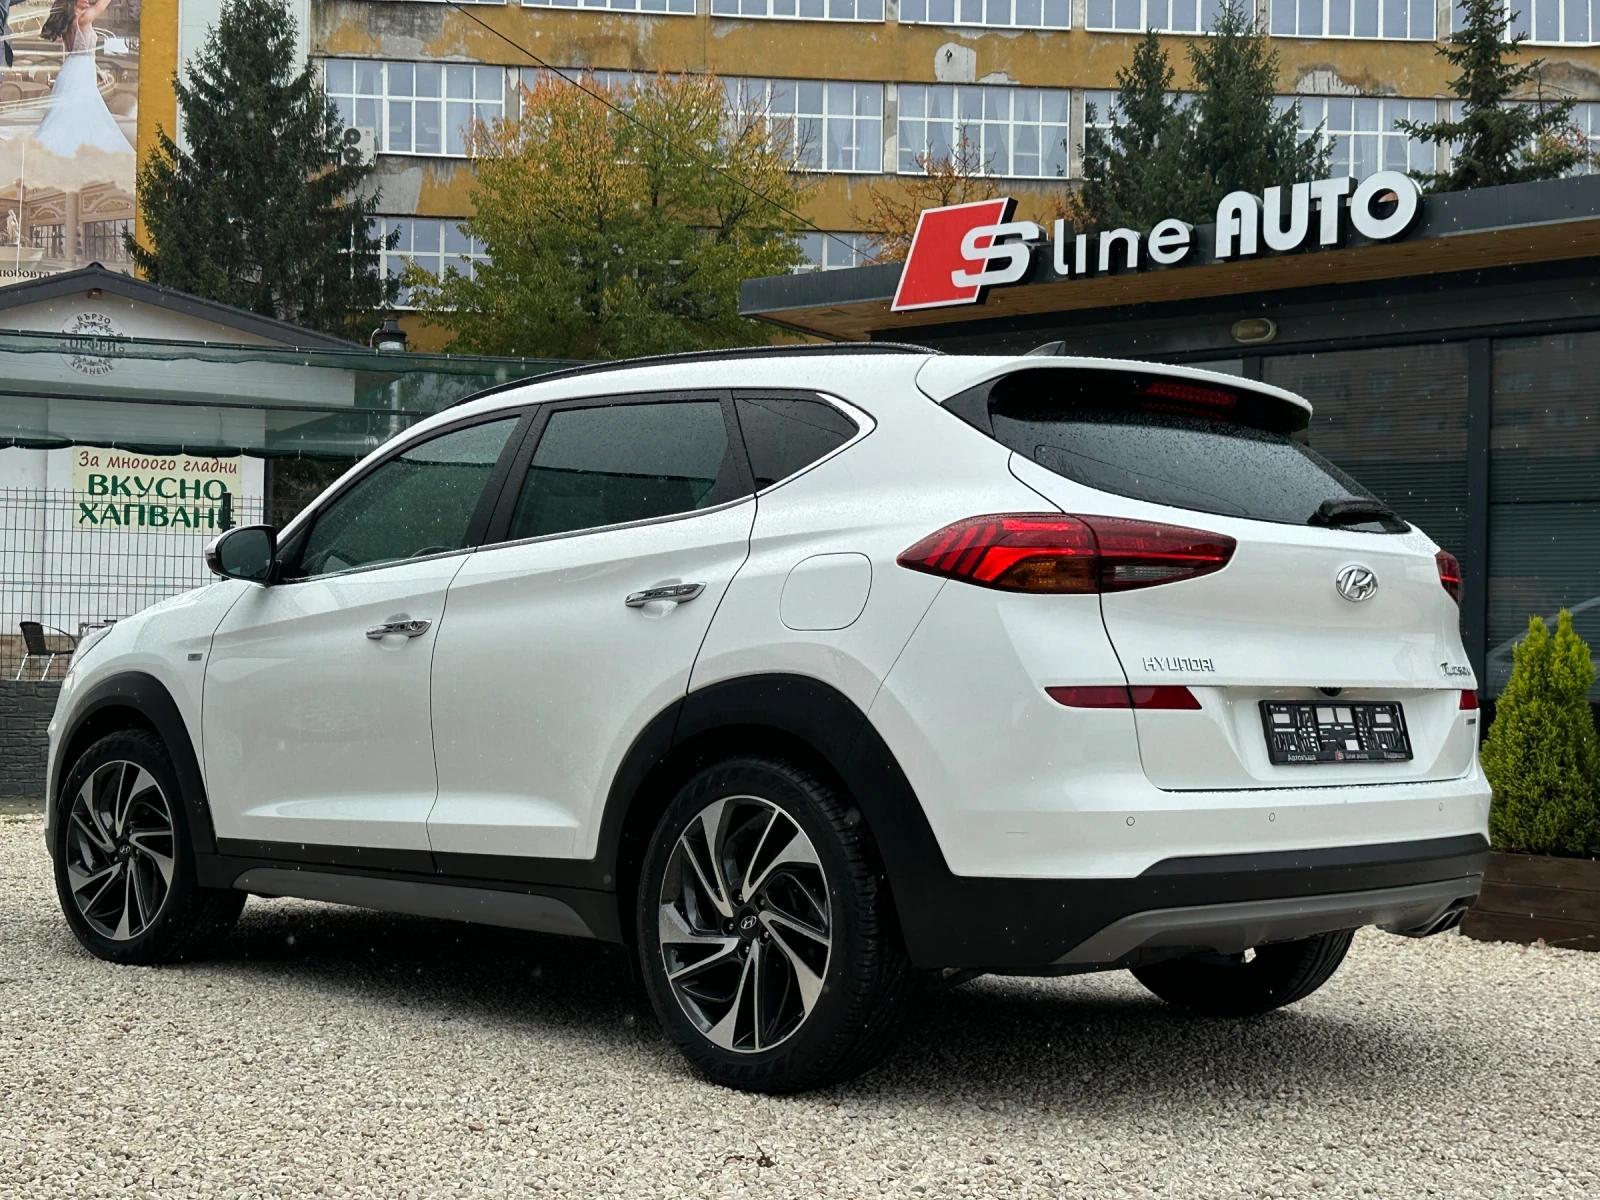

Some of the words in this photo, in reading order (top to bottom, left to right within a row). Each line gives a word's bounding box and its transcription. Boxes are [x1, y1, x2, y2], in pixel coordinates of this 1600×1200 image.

[1215, 170, 1421, 259] AUTO
[77, 313, 111, 325] БЪРЗО
[70, 360, 114, 374] ХРАНЕНЕ
[79, 450, 100, 468] За
[106, 454, 177, 471] мнооого
[183, 456, 238, 475] гладни
[88, 473, 228, 501] ВКУСНО
[1142, 656, 1216, 672] HYUNDAI
